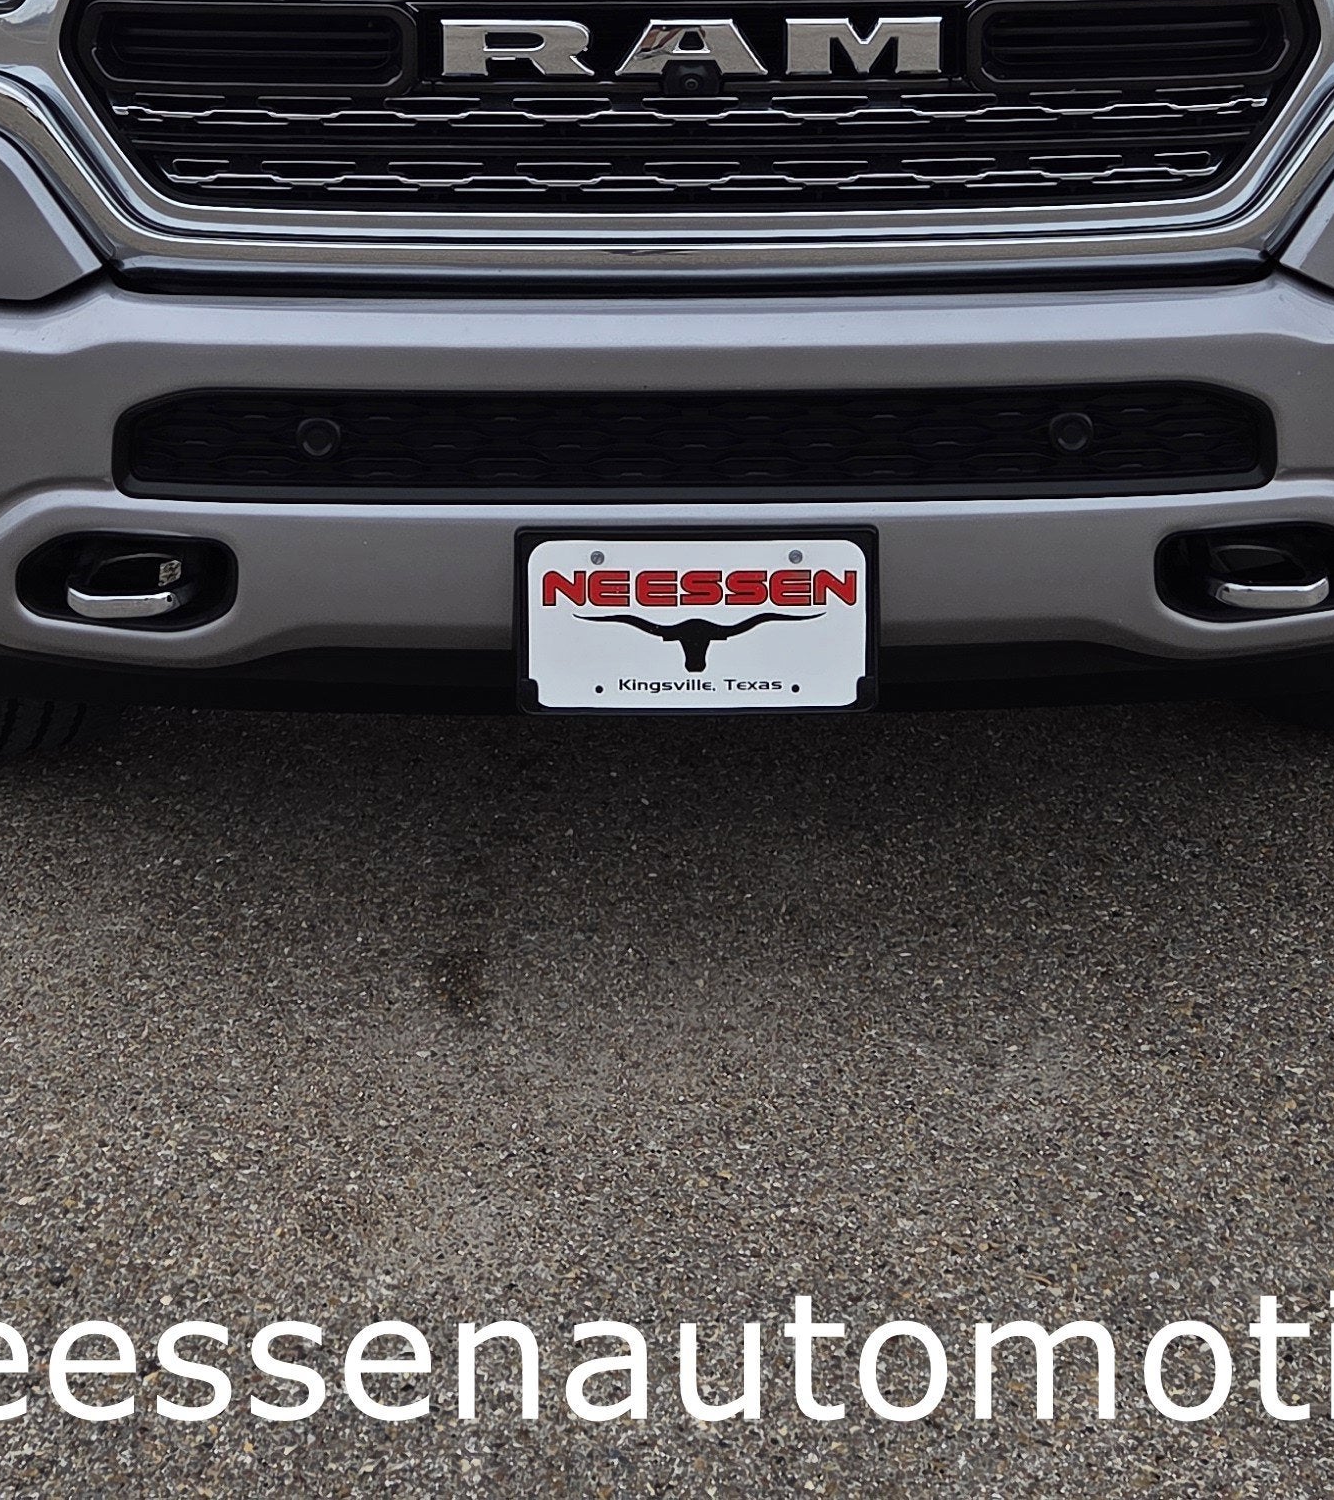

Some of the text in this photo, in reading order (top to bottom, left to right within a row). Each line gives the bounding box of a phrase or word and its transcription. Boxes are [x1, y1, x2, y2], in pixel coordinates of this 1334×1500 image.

[441, 18, 942, 76] RAM
[542, 569, 857, 607] NEESSEN
[619, 678, 782, 694] Kingsville, Texas
